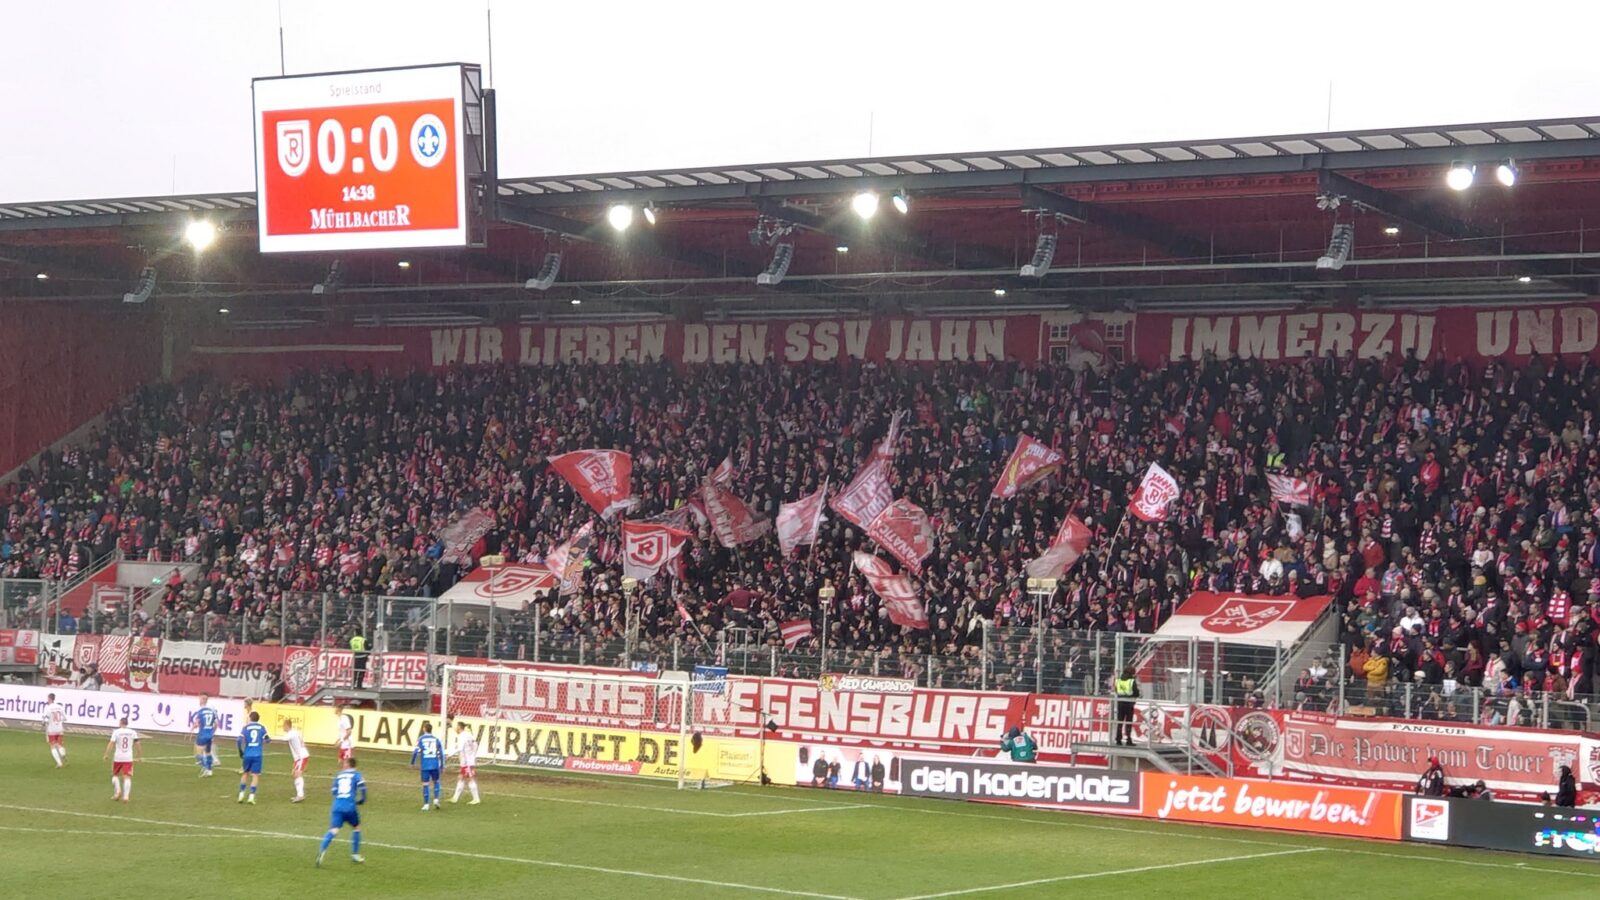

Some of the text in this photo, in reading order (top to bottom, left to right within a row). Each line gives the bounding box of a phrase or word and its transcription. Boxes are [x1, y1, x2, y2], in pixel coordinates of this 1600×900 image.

[329, 82, 382, 97] Spielstand
[317, 114, 398, 175] 0:0
[341, 185, 375, 202] 14:38
[309, 204, 411, 230] MÜHLBACHER
[430, 306, 1599, 366] WIR LIEBEN DEN SSV JAHN IMMERZU UND
[204, 644, 242, 657] Fanclub
[160, 656, 262, 682] REGENSBURG
[838, 678, 915, 692] RED GENERATION
[78, 699, 103, 719] der
[106, 702, 117, 720] A
[119, 703, 140, 721] 93
[500, 667, 1010, 742] ULTRAS REGENSBURG
[1031, 698, 1091, 729] JAHN
[249, 729, 258, 743] 9
[1392, 724, 1466, 735] FANCLUB
[121, 736, 129, 750] 8
[1310, 733, 1345, 757] Die
[1353, 736, 1420, 766] Power
[1475, 745, 1545, 774] Tower
[571, 759, 633, 773] Photovoltaik
[910, 766, 1130, 803] dein kaderplatz
[1157, 781, 1227, 818] jetzt
